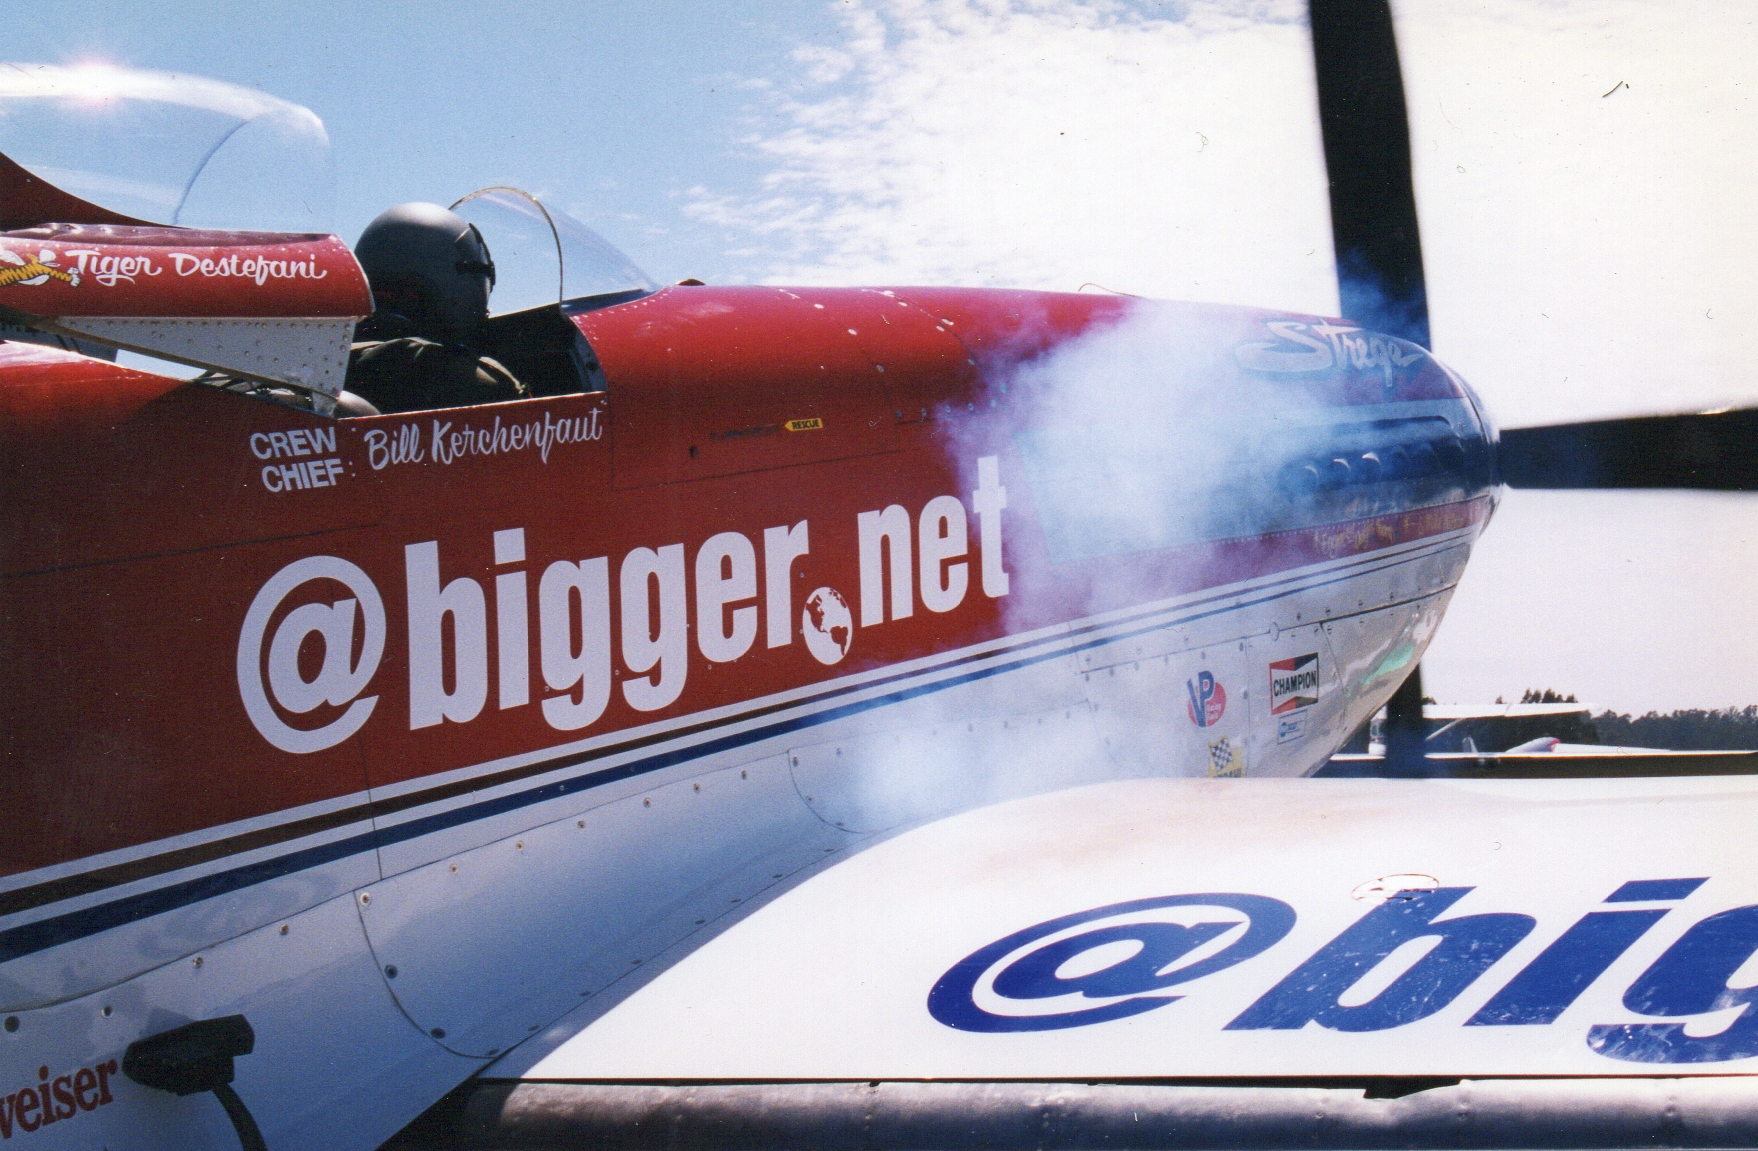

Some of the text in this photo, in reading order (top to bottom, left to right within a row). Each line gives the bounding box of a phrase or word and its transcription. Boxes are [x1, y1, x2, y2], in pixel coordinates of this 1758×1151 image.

[65, 249, 328, 287] Tiger Destefani
[1234, 317, 1424, 388] Strega
[364, 407, 604, 470] Bill Kerchenfaut
[791, 419, 820, 430] RESCUE
[249, 427, 337, 460] CREW
[261, 458, 345, 493] CHIEF
[1187, 670, 1215, 728] VP
[1273, 670, 1317, 698] CHAMPION
